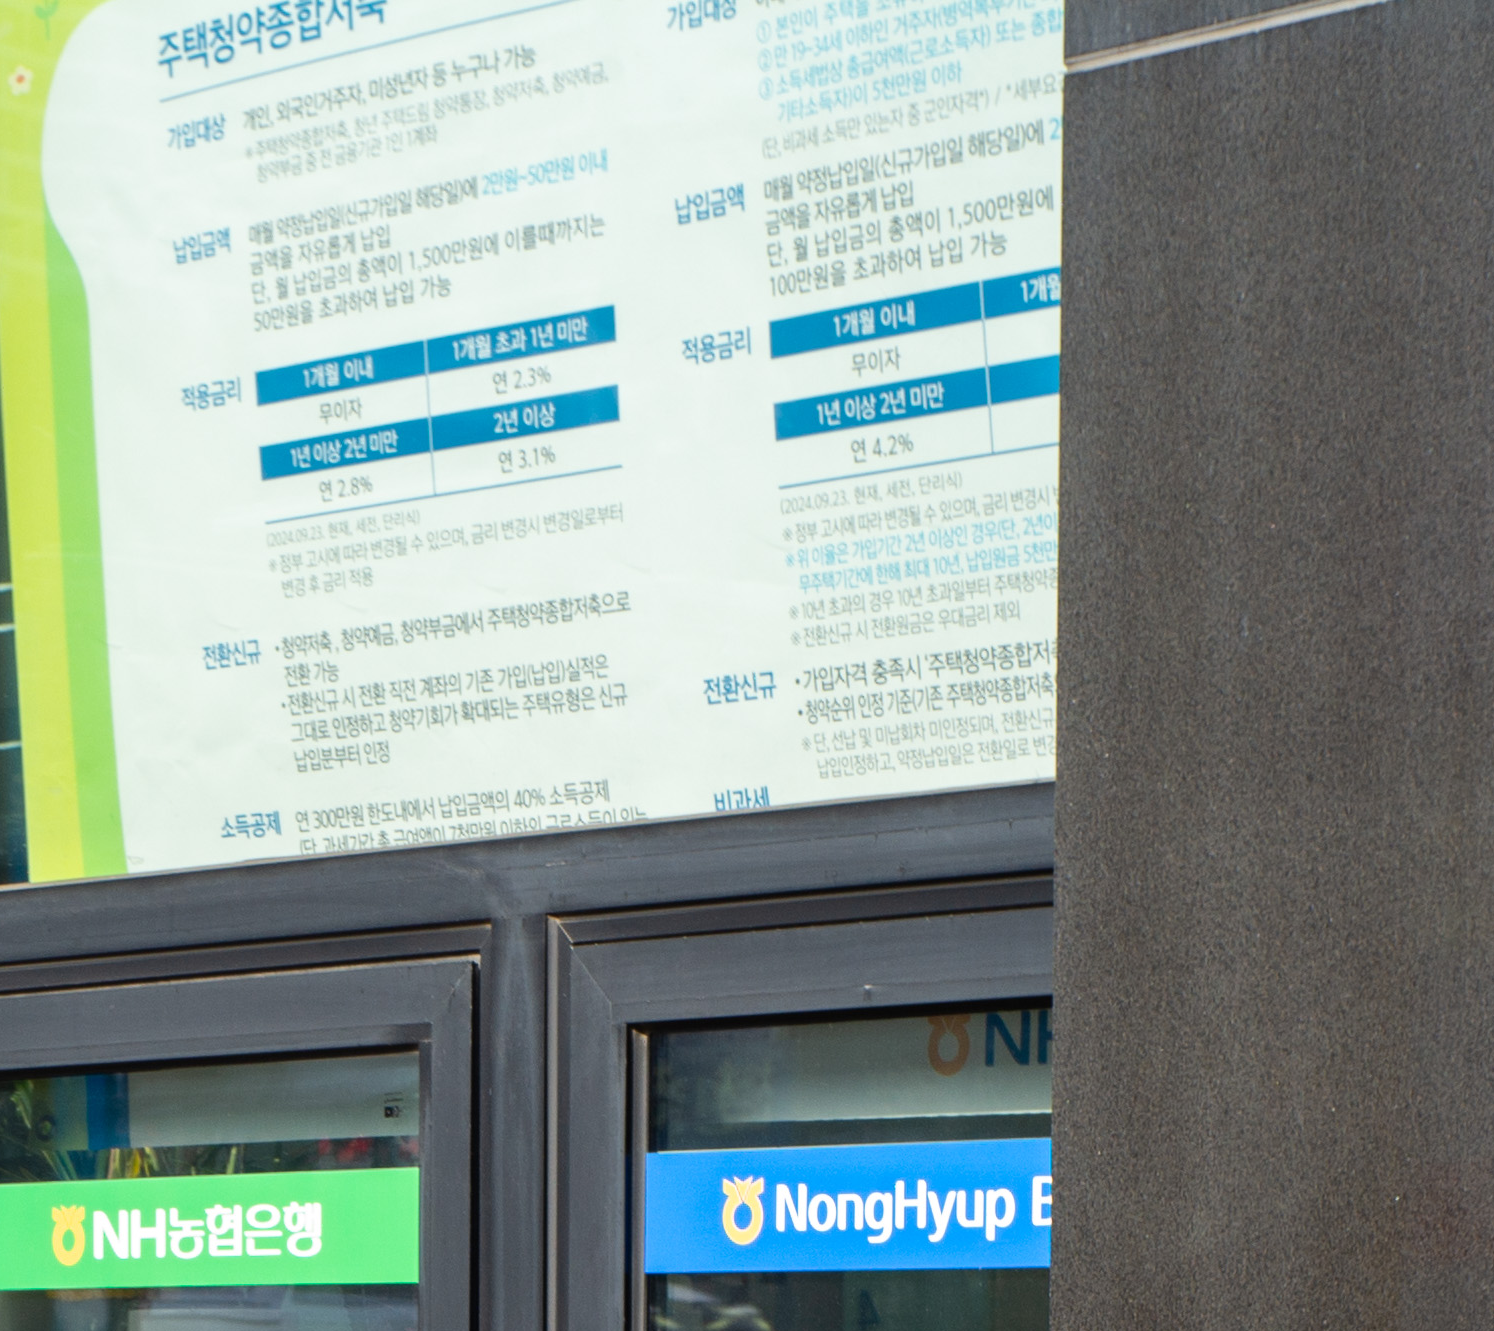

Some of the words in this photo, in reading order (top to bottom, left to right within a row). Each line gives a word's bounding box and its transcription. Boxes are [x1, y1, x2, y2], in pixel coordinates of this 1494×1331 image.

[503, 44, 536, 69] 가능
[578, 147, 608, 174] 이내
[674, 183, 745, 225] 납입금액
[763, 174, 793, 201] 매월
[765, 202, 811, 236] 금액을
[814, 187, 877, 222] 자유롭게
[880, 180, 914, 211] 납입
[766, 240, 788, 268] 단,
[793, 235, 808, 262] 월
[813, 219, 881, 258] 납입금의
[888, 207, 940, 243] 총액이
[948, 184, 1054, 229] 1,500만원에
[172, 227, 231, 265] 납입금액
[298, 231, 356, 263] 자유롭게
[360, 224, 391, 252] 납입
[292, 262, 352, 296] 납입금의
[769, 259, 846, 296] 100만원을
[853, 244, 921, 280] 초과하여
[928, 236, 963, 268] 납입
[970, 230, 1007, 257] 가능
[318, 286, 378, 318] 초과하여
[382, 279, 414, 308] 납입
[420, 274, 451, 298] 가능
[833, 307, 874, 336] 1개월
[879, 300, 915, 329] 이내
[452, 334, 491, 360] 1개월
[494, 327, 527, 353] 초과
[530, 322, 553, 348] 1년
[556, 316, 587, 342] 미만
[681, 326, 751, 364] 적용금리
[300, 357, 339, 387] 1개월
[339, 349, 375, 381] 이내
[851, 345, 901, 377] 무이자
[181, 376, 241, 410] 적용금리
[492, 370, 507, 395] 연
[512, 365, 551, 389] 2.3%
[319, 397, 362, 424] 무이자
[493, 408, 518, 433] 2년
[522, 401, 555, 428] 이상
[816, 399, 840, 426] 1년
[844, 393, 876, 421] 이상
[879, 387, 905, 415] 2년
[909, 381, 944, 409] 미만
[289, 444, 311, 468] 1년
[312, 439, 345, 464] 이상
[343, 434, 367, 459] 2년
[368, 429, 398, 454] 미만
[497, 449, 512, 474] 연
[518, 445, 556, 469] 3.1%
[850, 438, 866, 463] 연
[871, 432, 913, 457] 4.2%
[318, 479, 332, 502] 연
[336, 475, 373, 498] 2.8%
[993, 599, 1020, 622] 제외
[202, 639, 261, 670] 전환신규
[283, 662, 310, 687] 전환
[313, 660, 339, 683] 가능
[703, 670, 776, 705] 전환신규
[803, 661, 867, 692] 가입자격
[871, 654, 921, 685] 충족시
[287, 688, 339, 716] 전환신규
[342, 685, 356, 708] 시
[358, 681, 386, 707] 전환
[388, 678, 416, 702] 직전
[419, 672, 461, 698] 계좌의
[465, 668, 494, 693] 기존
[805, 694, 855, 725] 청약순위
[857, 691, 884, 718] 인정
[886, 684, 943, 714] 기준(기존
[291, 719, 331, 742] 그대로
[331, 712, 386, 739] 인정하고
[388, 702, 458, 733] 청약기회가
[460, 696, 519, 723] 확대되는
[522, 685, 595, 716] 주택유형은
[598, 682, 628, 708] 신규
[293, 743, 361, 773] 납입분부터
[362, 740, 390, 765] 인정
[294, 809, 310, 833] 연
[312, 804, 364, 829] 300만원
[366, 796, 435, 826] 한도내에서
[437, 788, 510, 819] 납입금액의
[513, 787, 545, 808] 40%
[549, 778, 610, 805] 소득공제
[711, 785, 772, 812] 비과세
[220, 810, 281, 838] 소득공제
[775, 1179, 1015, 1244] NongHyup
[91, 1202, 323, 1263] NH농협은행
